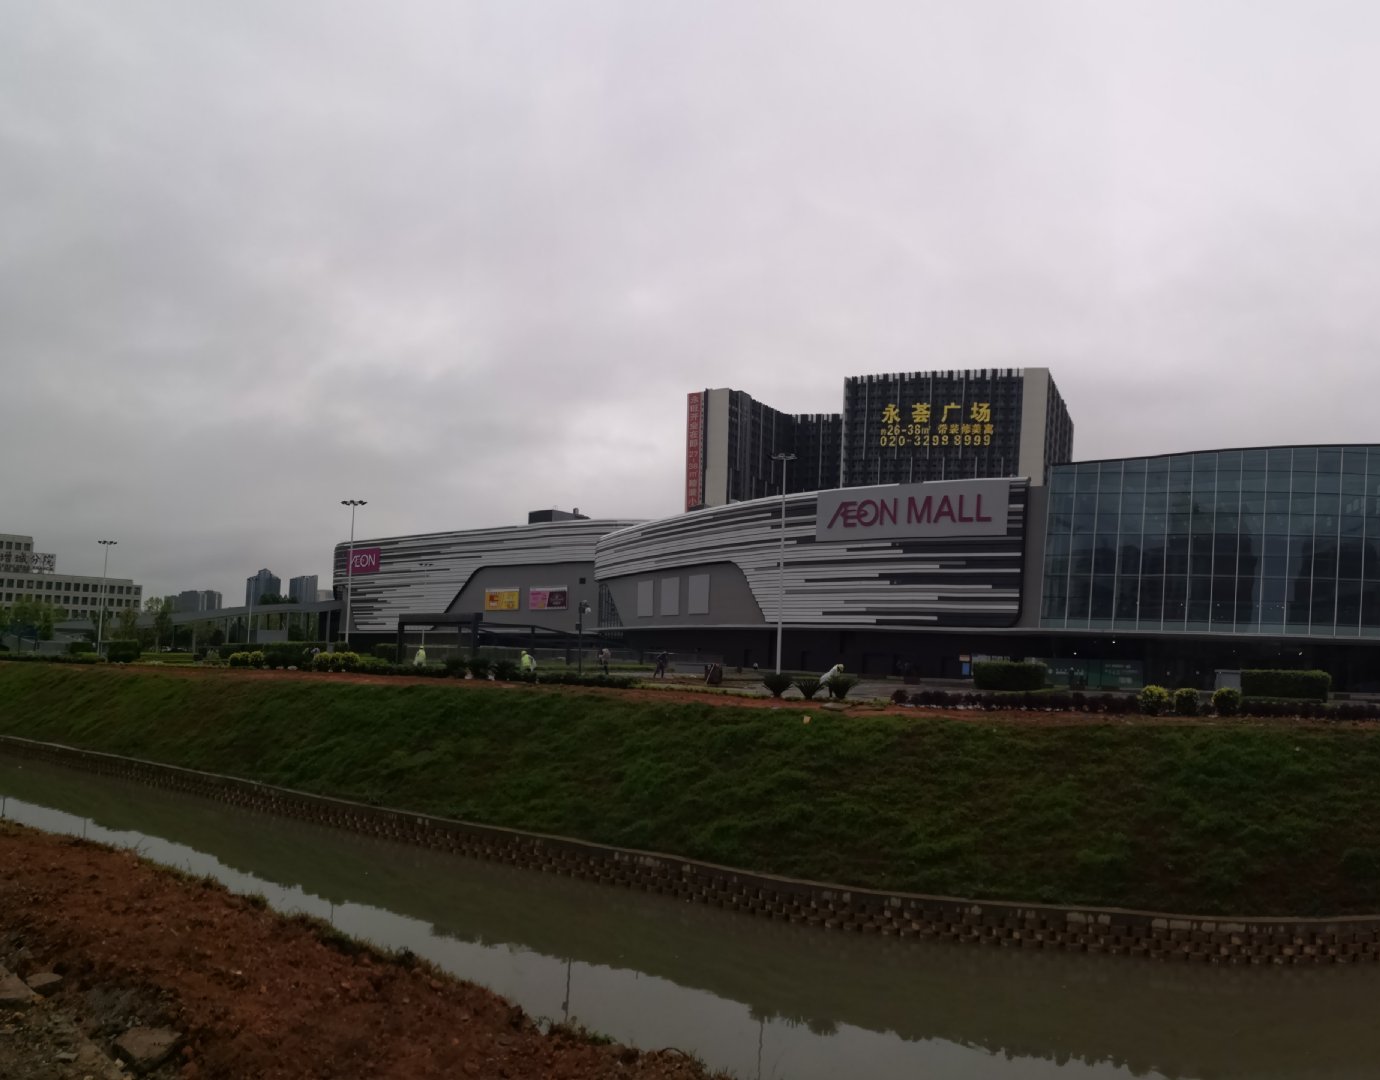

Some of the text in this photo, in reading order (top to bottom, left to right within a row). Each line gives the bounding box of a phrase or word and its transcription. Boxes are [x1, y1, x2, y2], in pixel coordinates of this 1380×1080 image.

[881, 402, 991, 424] 永荟广场
[906, 493, 992, 524] MALL
